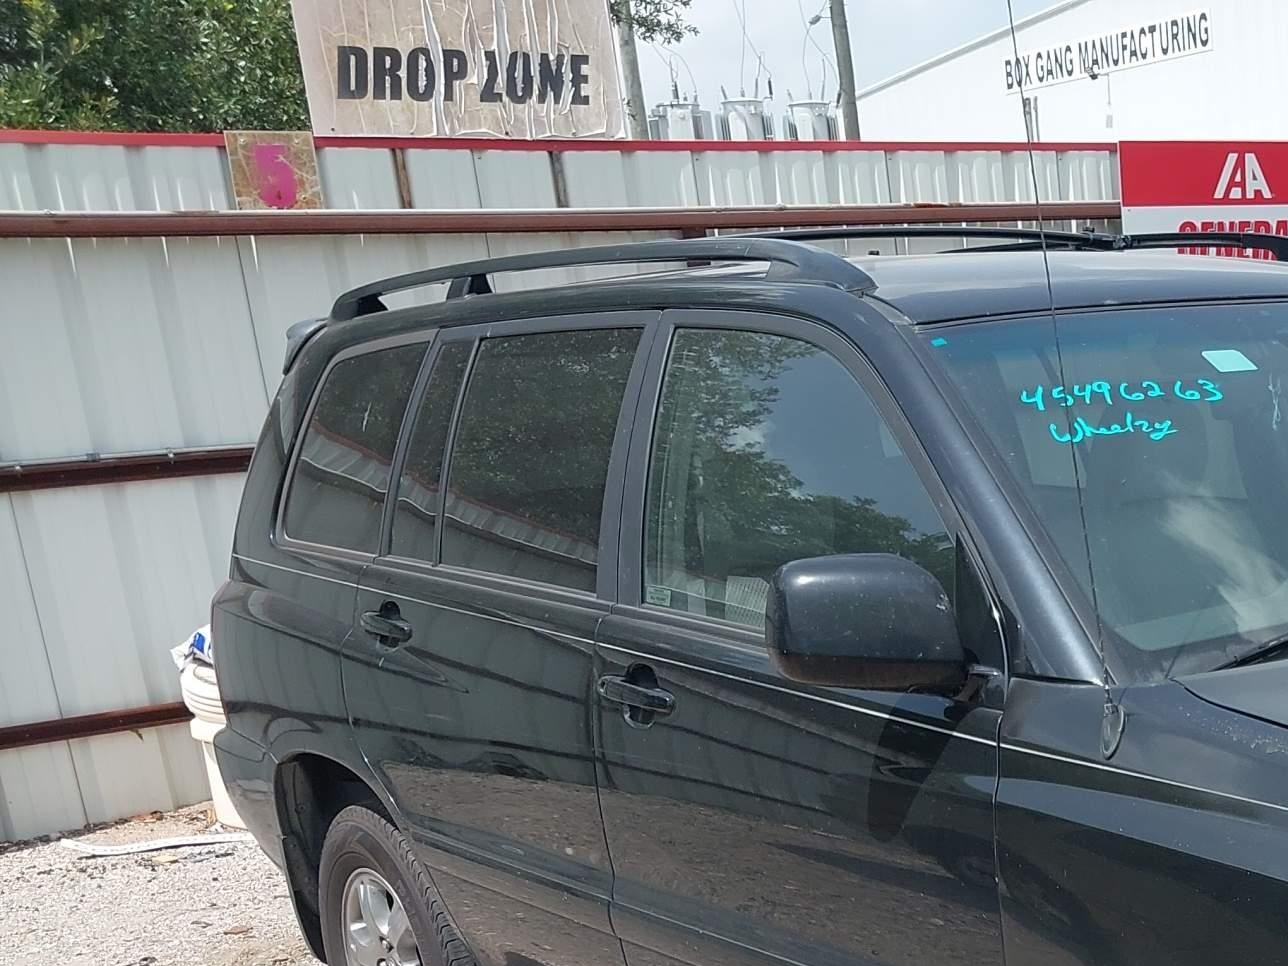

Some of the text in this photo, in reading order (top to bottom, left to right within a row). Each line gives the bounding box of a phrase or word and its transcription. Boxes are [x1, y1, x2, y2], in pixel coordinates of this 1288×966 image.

[337, 45, 591, 106] DROP ZONE
[1004, 11, 1211, 90] BOX GANG MANUFACTURING
[253, 143, 299, 209] 5
[1020, 379, 1225, 412] 45496263
